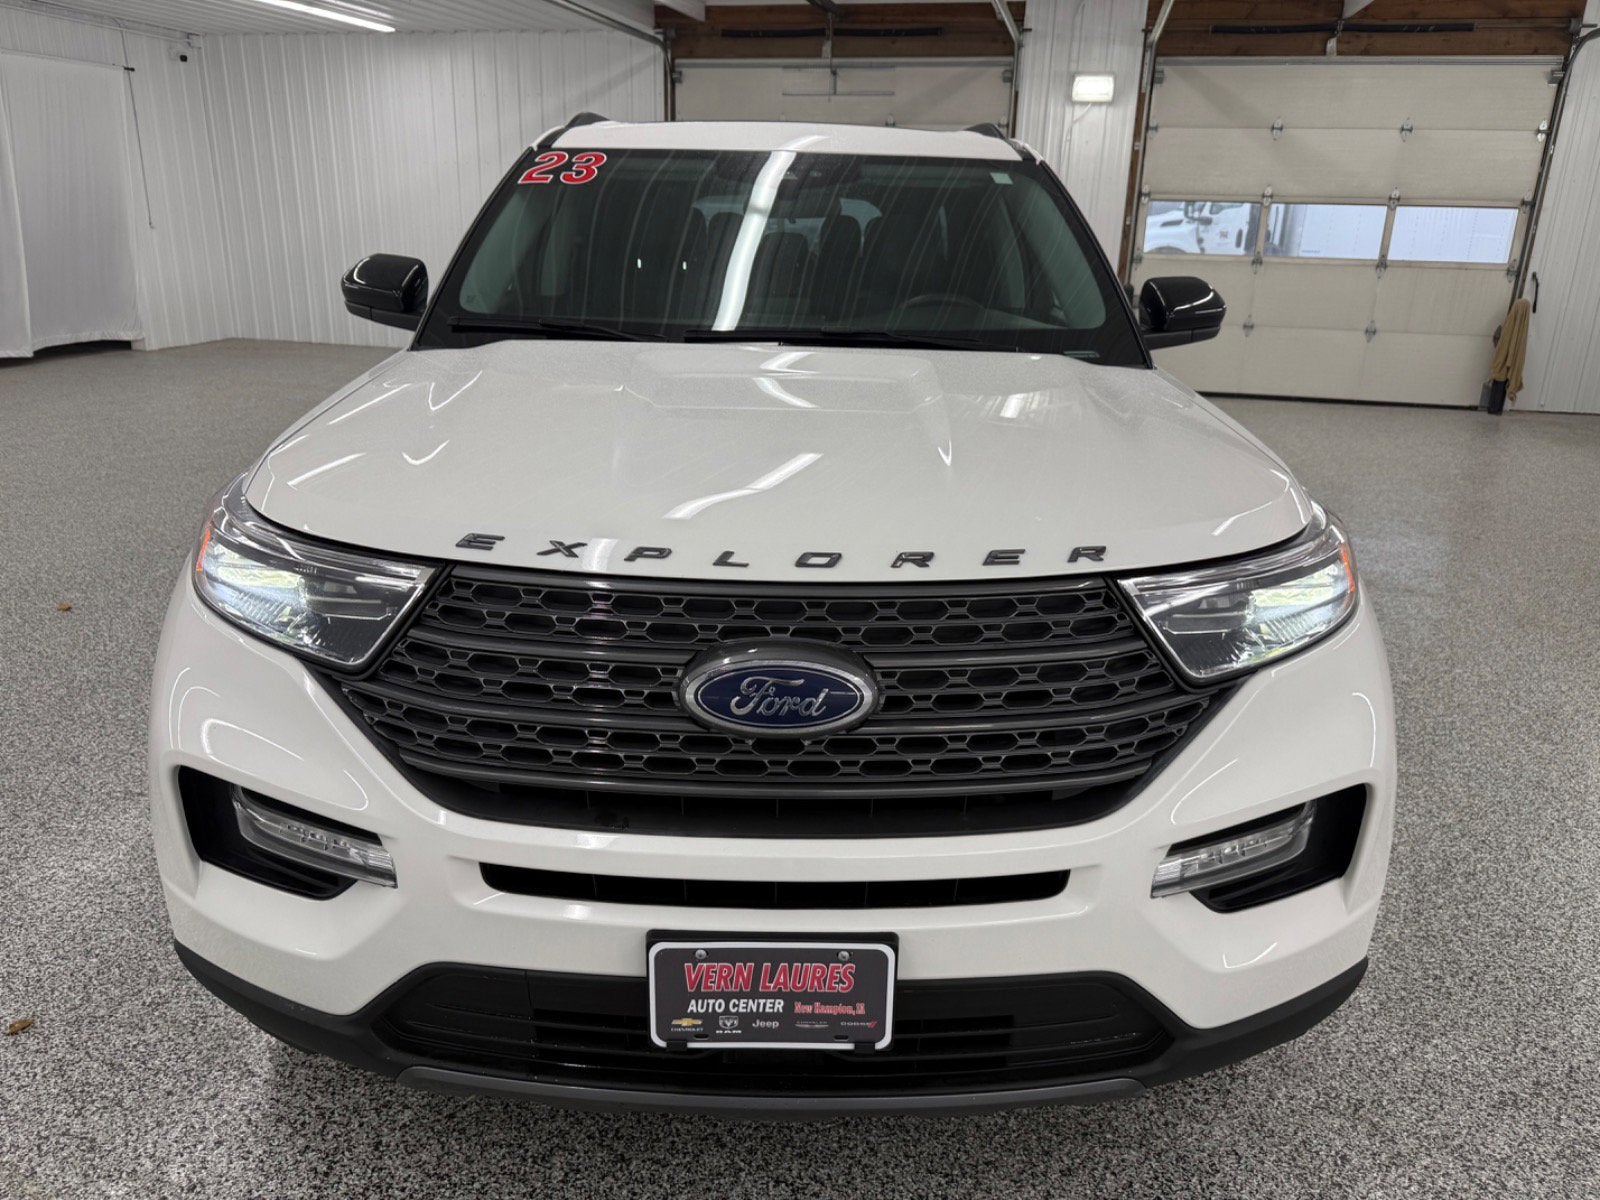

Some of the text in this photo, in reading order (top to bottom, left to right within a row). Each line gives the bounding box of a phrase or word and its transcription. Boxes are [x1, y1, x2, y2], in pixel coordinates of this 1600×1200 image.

[517, 151, 607, 185] 23
[455, 532, 1107, 569] EXPLORER
[730, 676, 829, 716] Ford
[684, 963, 856, 993] VERN LAURES
[687, 998, 784, 1013] AUTO CENTER
[794, 1001, 812, 1014] New
[752, 1019, 780, 1029] Jeep
